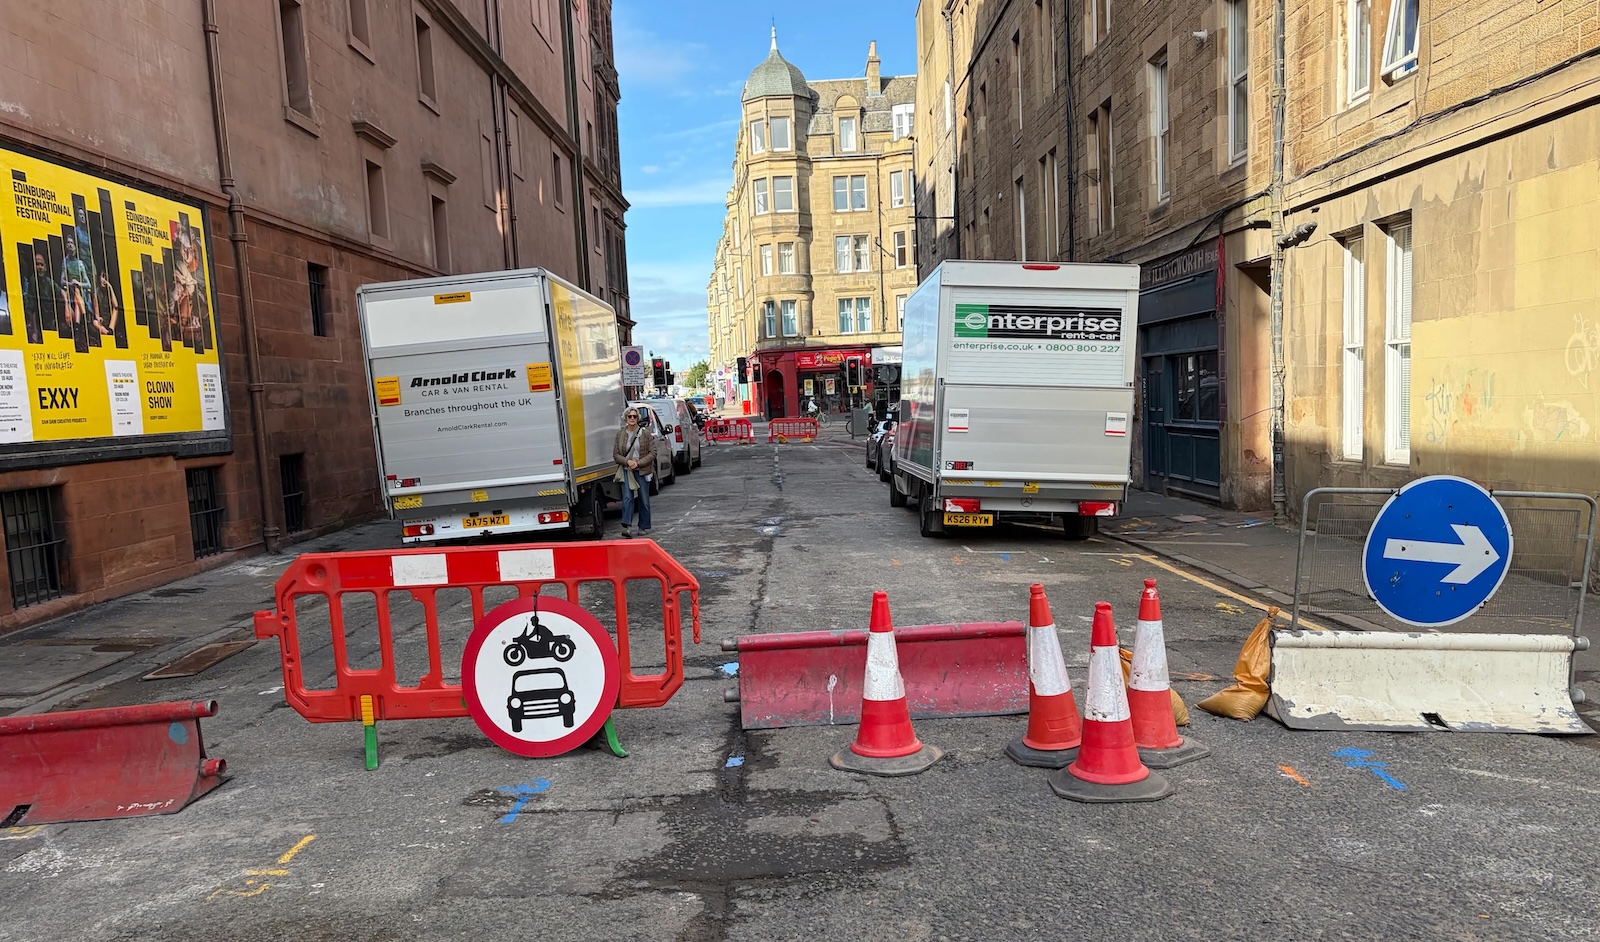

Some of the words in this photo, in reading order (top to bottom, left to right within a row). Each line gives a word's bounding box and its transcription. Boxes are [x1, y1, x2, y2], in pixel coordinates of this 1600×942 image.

[12, 181, 56, 202] EDINBURGH
[14, 194, 72, 217] INTERNATIONAL
[16, 206, 51, 224] FESTIVAL
[126, 210, 158, 228] EDINBURGH
[127, 222, 170, 240] INTERNATIONAL
[128, 232, 154, 246] FESTIVAL
[1152, 248, 1204, 285] ILLINGWORTH
[557, 306, 572, 332] Hire
[964, 312, 1120, 336] enterprise
[1060, 332, 1118, 340] rent-a-car
[562, 338, 572, 359] me
[953, 342, 1034, 351] enterprise.co.uk
[1045, 344, 1074, 352] 0800
[1076, 344, 1098, 353] 800
[1100, 345, 1120, 353] 227
[410, 372, 470, 388] Arnold
[471, 368, 517, 384] Clark
[146, 381, 175, 394] CLOWN
[473, 383, 508, 392] RENTAL
[38, 387, 79, 410] EXXY
[148, 396, 172, 409] SHOW
[404, 406, 446, 417] Branches
[447, 401, 499, 414] throughout
[502, 399, 516, 408] the
[518, 397, 532, 406] UK
[437, 420, 508, 433] ArnoldClarkRental.com
[466, 517, 488, 527] SA75
[490, 515, 507, 525] MZT
[947, 515, 970, 524] KS26
[972, 516, 990, 525] RYW
